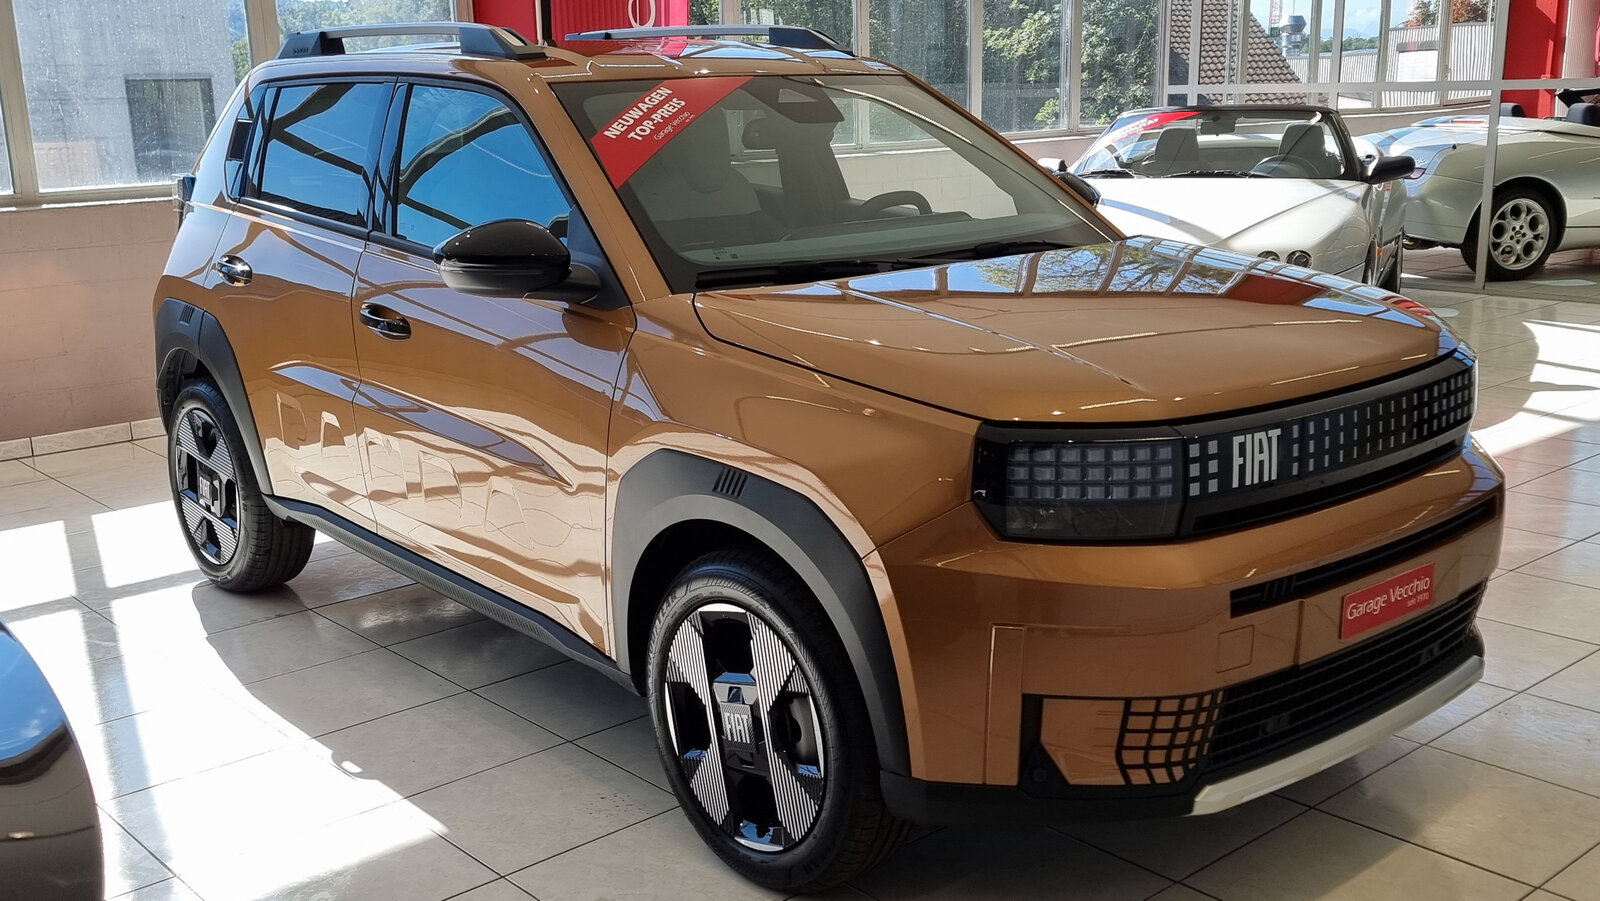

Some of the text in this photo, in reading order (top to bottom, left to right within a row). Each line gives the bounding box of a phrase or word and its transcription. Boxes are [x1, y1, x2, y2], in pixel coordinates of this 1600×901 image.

[603, 86, 673, 139] NEUWAGEN
[627, 97, 686, 141] TOP-PREIS
[653, 125, 674, 140] Garage
[1232, 427, 1282, 489] FIAT
[1347, 576, 1431, 620] Garage Vecchio
[723, 712, 751, 744] FIAT
